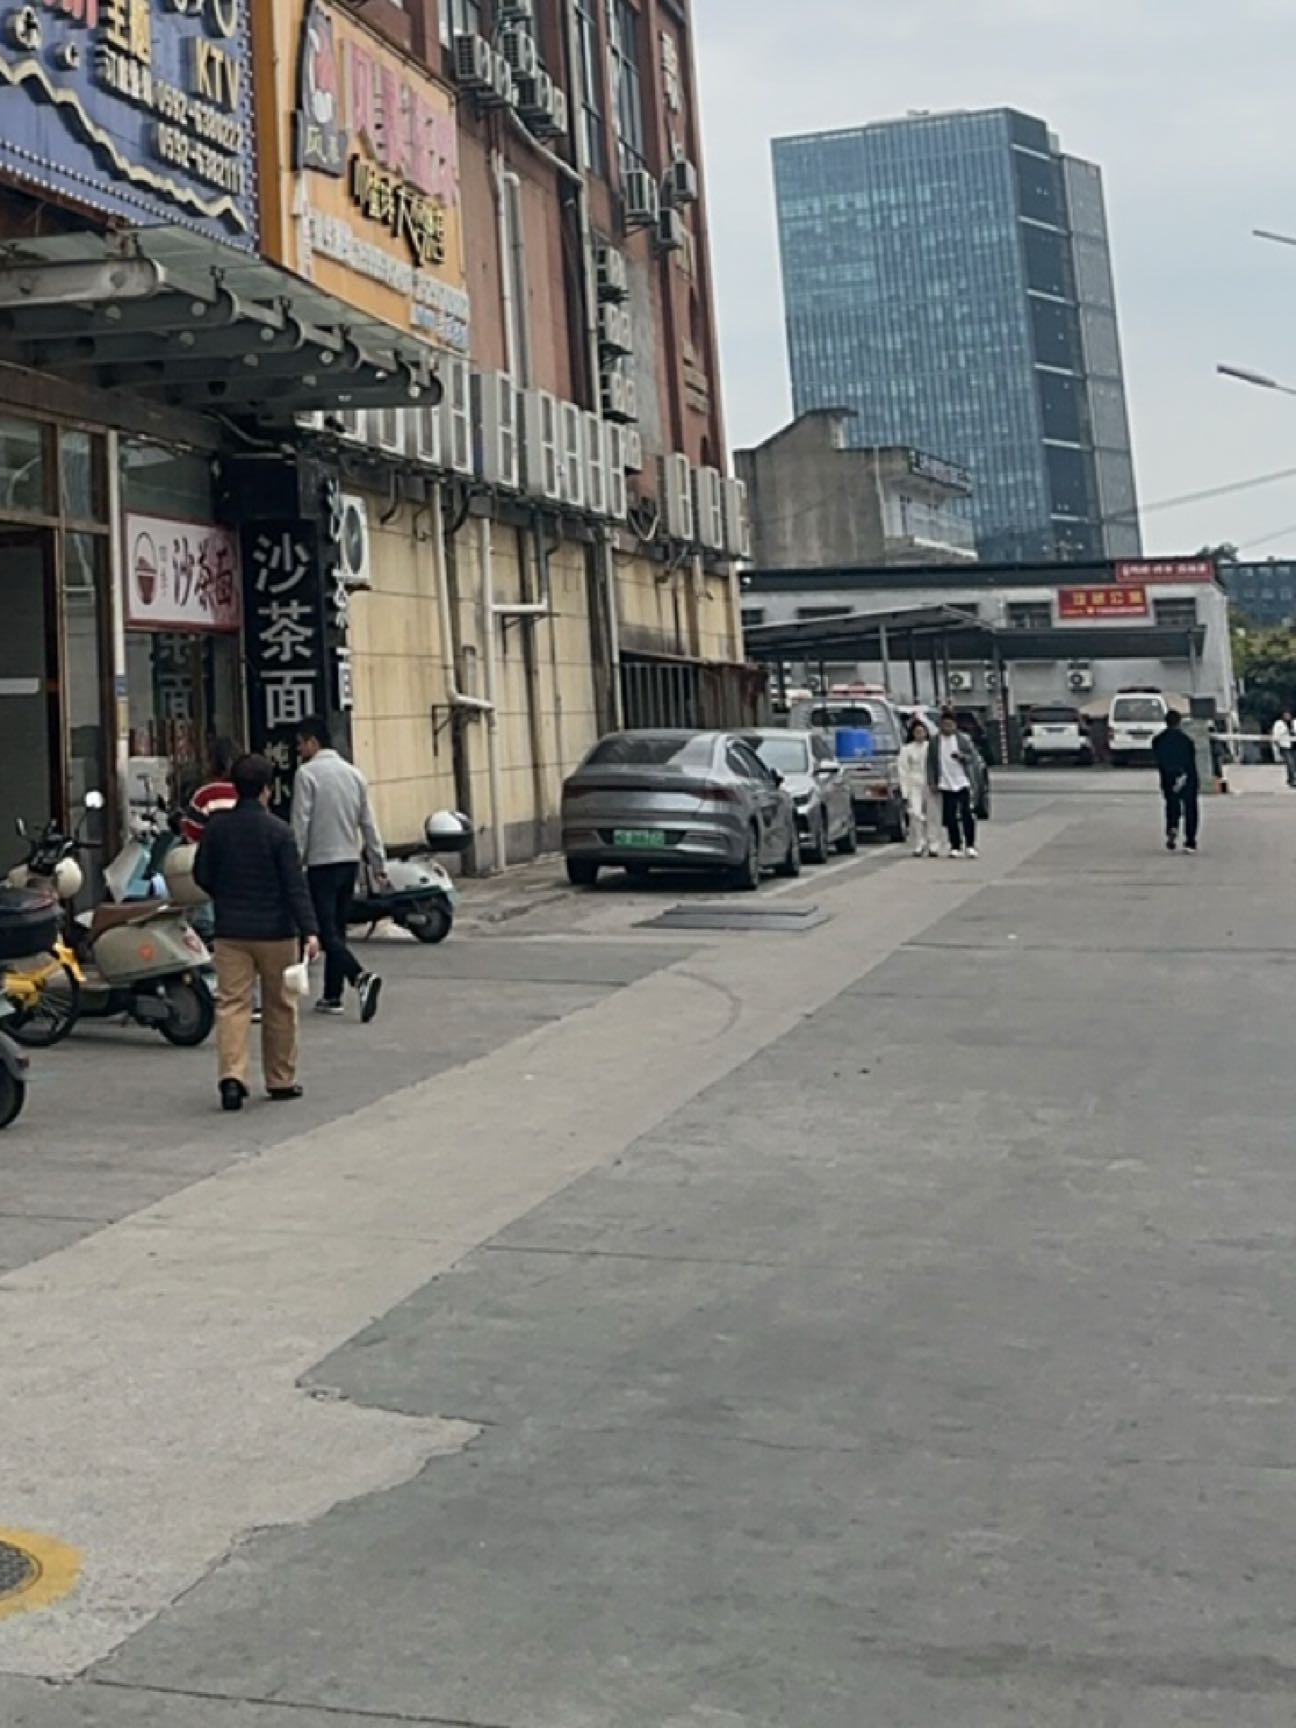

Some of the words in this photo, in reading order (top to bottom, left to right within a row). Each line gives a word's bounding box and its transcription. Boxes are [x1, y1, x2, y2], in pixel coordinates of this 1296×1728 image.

[192, 36, 240, 113] KTV
[253, 532, 318, 729] 沙茶面
